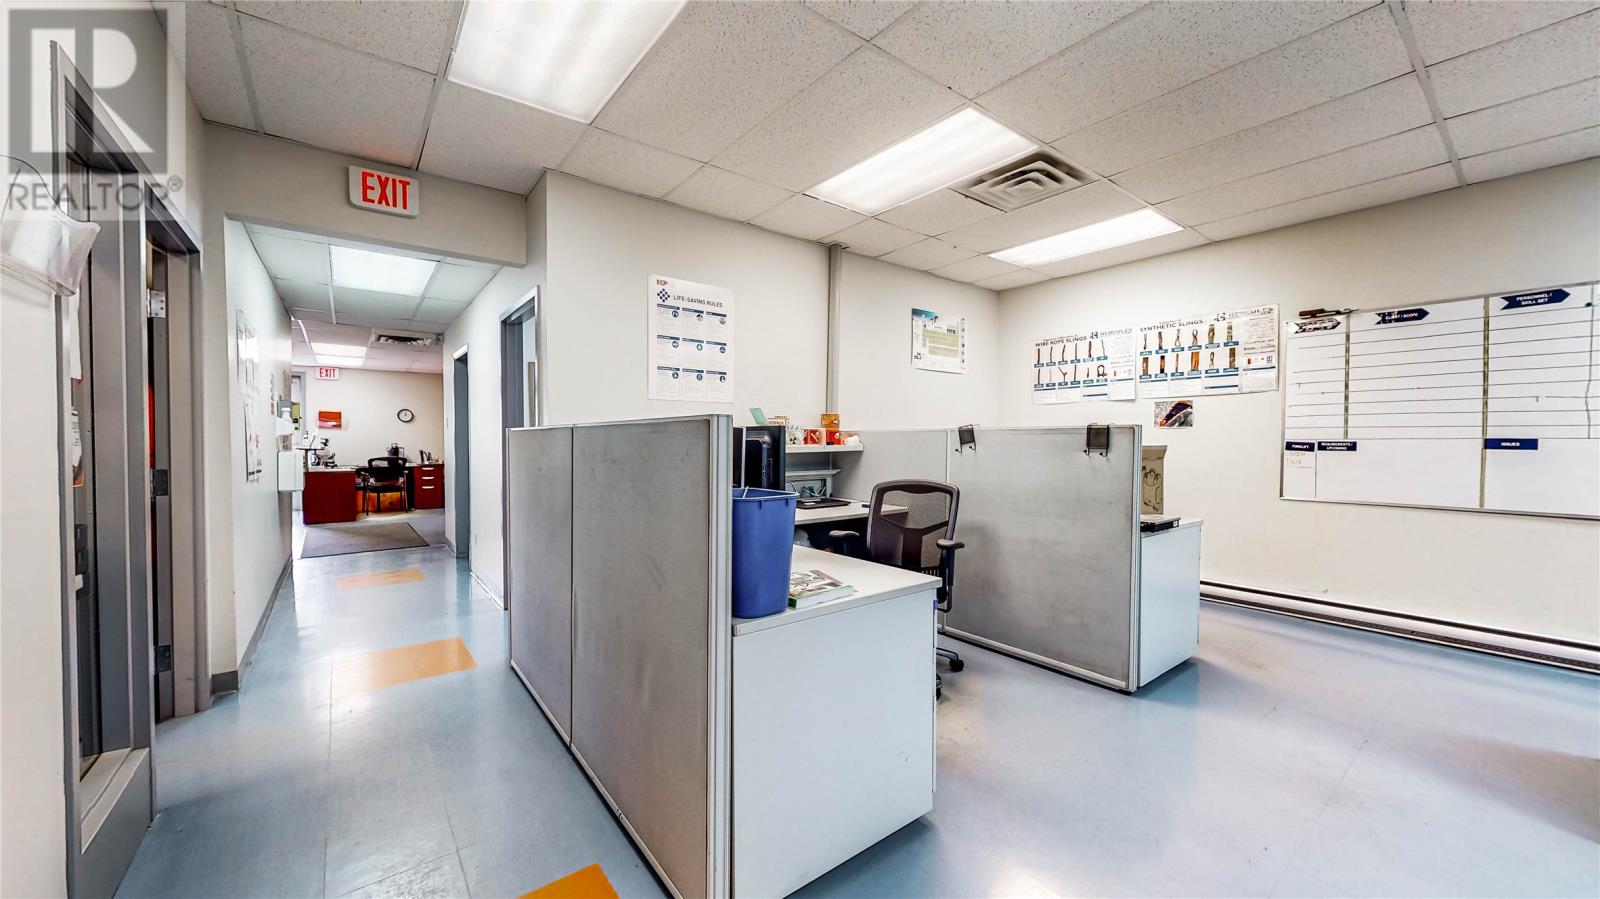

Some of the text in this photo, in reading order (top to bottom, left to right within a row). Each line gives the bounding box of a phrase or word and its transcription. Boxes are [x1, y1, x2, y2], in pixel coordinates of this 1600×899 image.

[361, 171, 411, 210] EXIT
[673, 295, 705, 305] LIFE-SAVING
[1139, 322, 1178, 332] SYNTHETIC
[1178, 319, 1204, 327] SLINGS
[1066, 336, 1087, 344] SLINGS
[319, 367, 337, 378] EXIT
